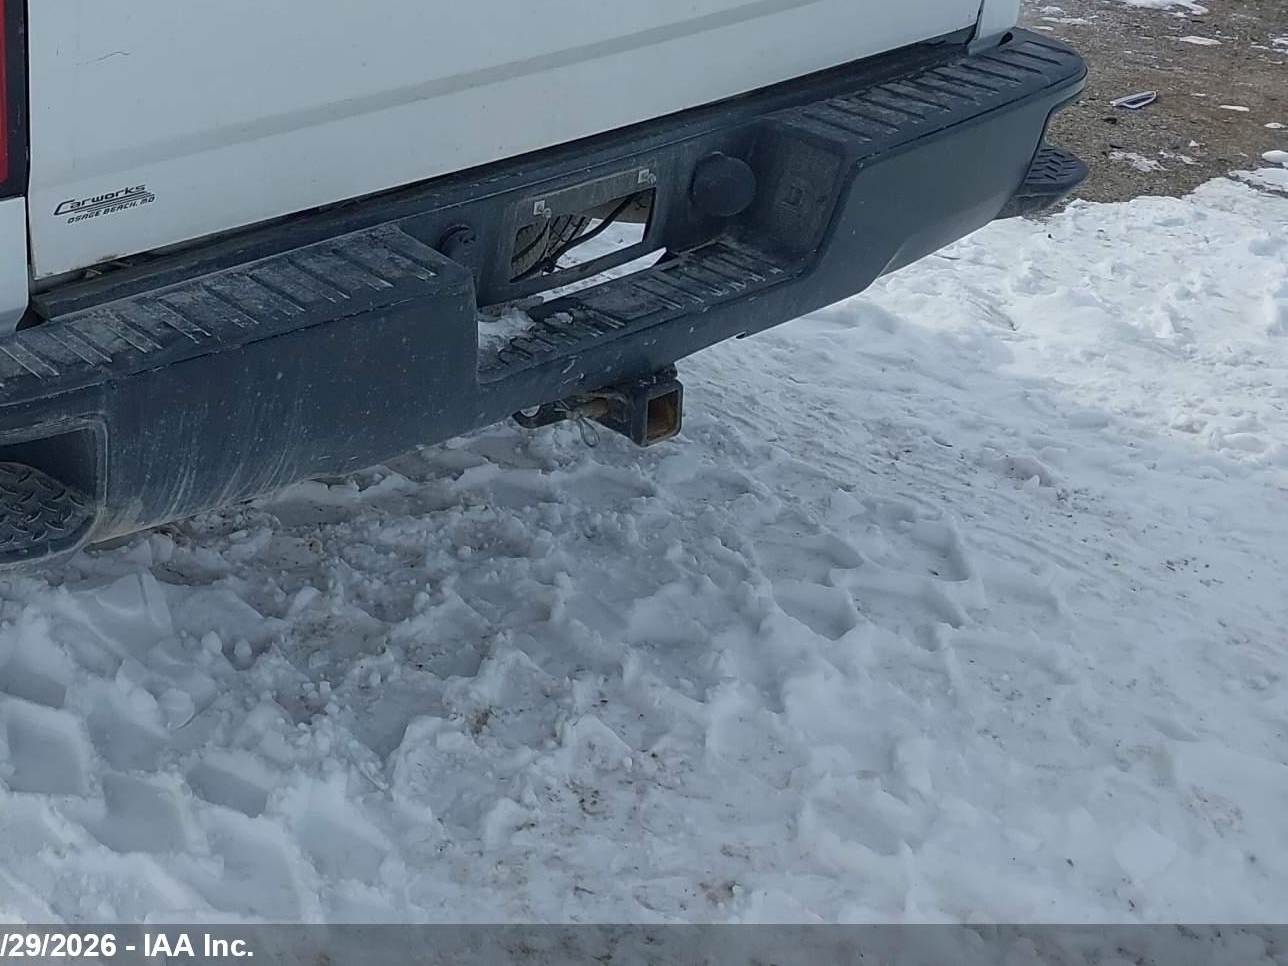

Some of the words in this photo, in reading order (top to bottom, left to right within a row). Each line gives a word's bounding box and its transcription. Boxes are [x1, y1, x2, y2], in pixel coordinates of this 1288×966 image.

[53, 184, 147, 216] Carworks
[67, 209, 102, 224] OSAGE
[139, 196, 155, 205] MO
